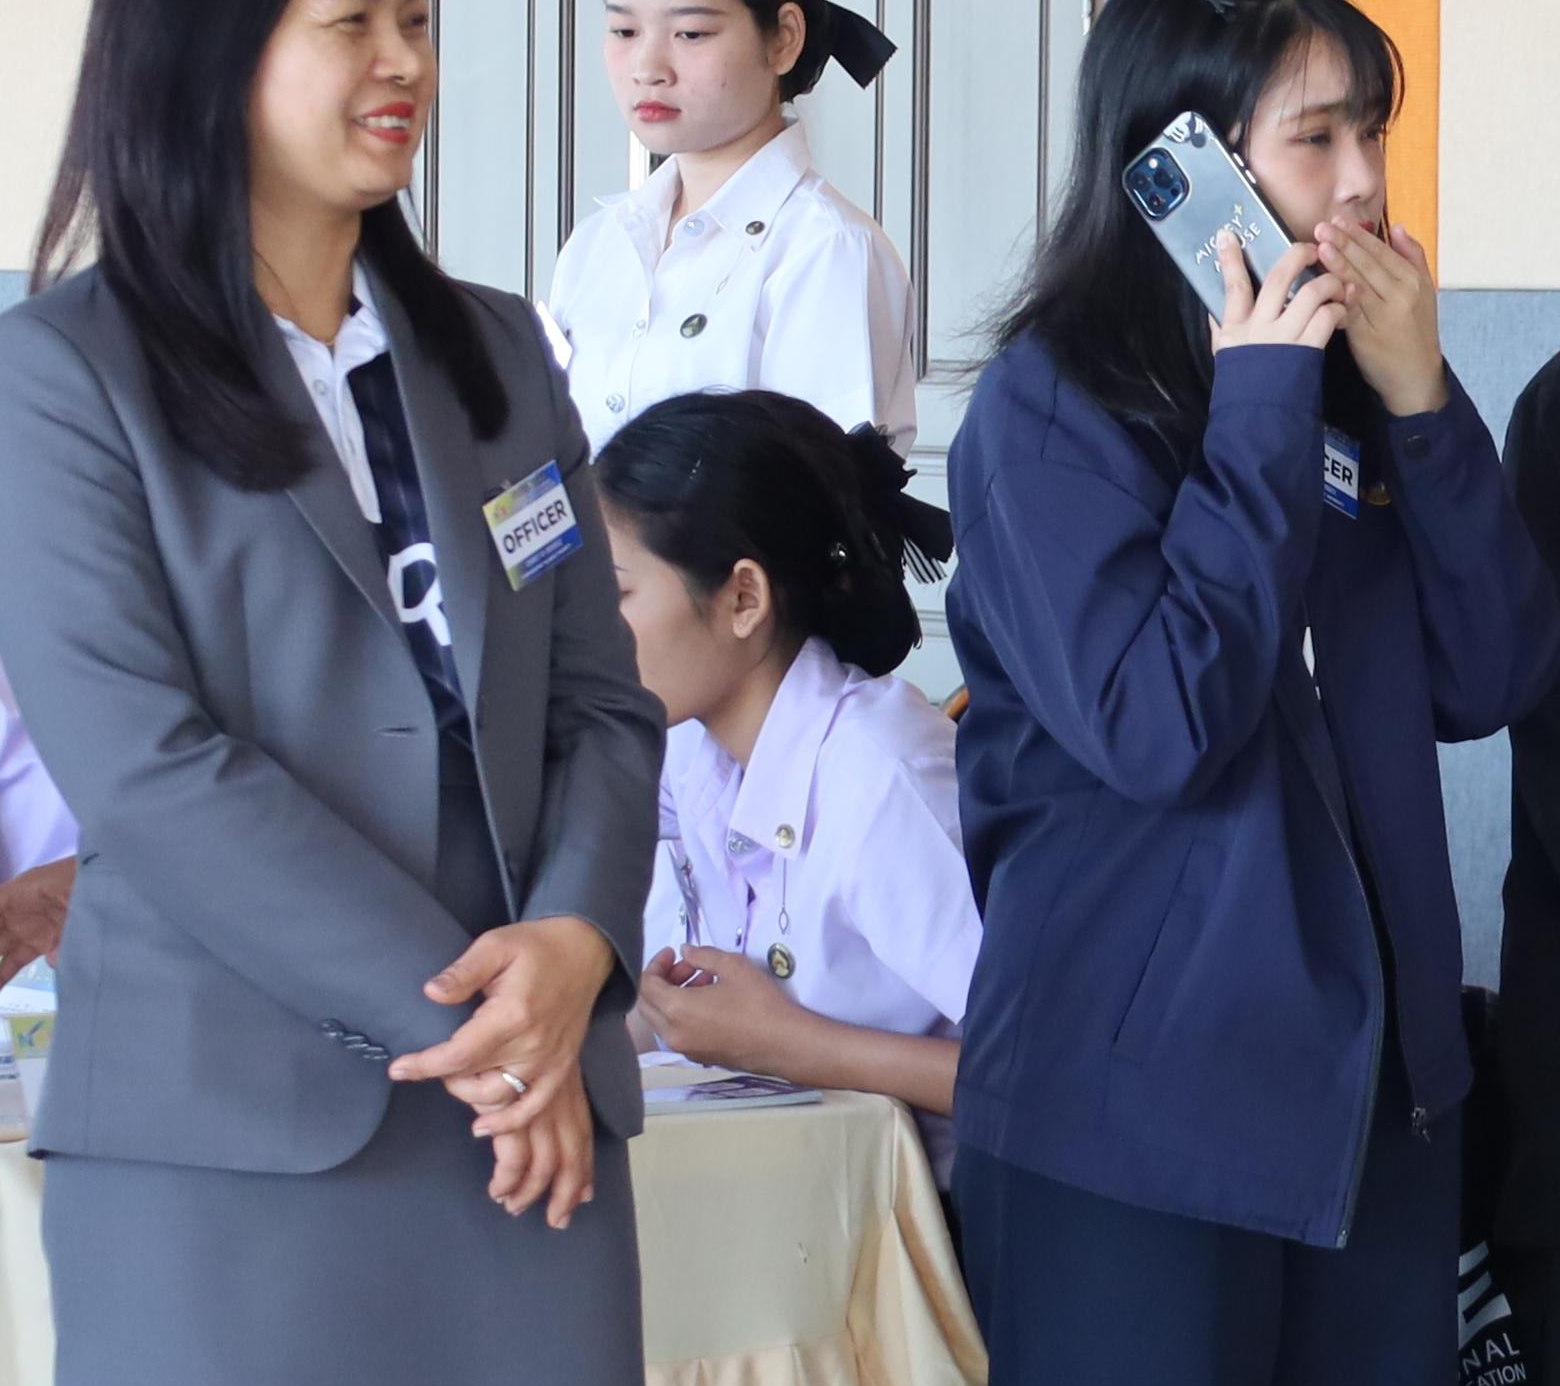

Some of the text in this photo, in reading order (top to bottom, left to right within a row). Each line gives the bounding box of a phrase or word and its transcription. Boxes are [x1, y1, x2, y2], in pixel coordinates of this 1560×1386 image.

[1195, 215, 1243, 265] MICEY
[502, 499, 568, 555] OFFICER
[1458, 1332, 1521, 1381] NAL
